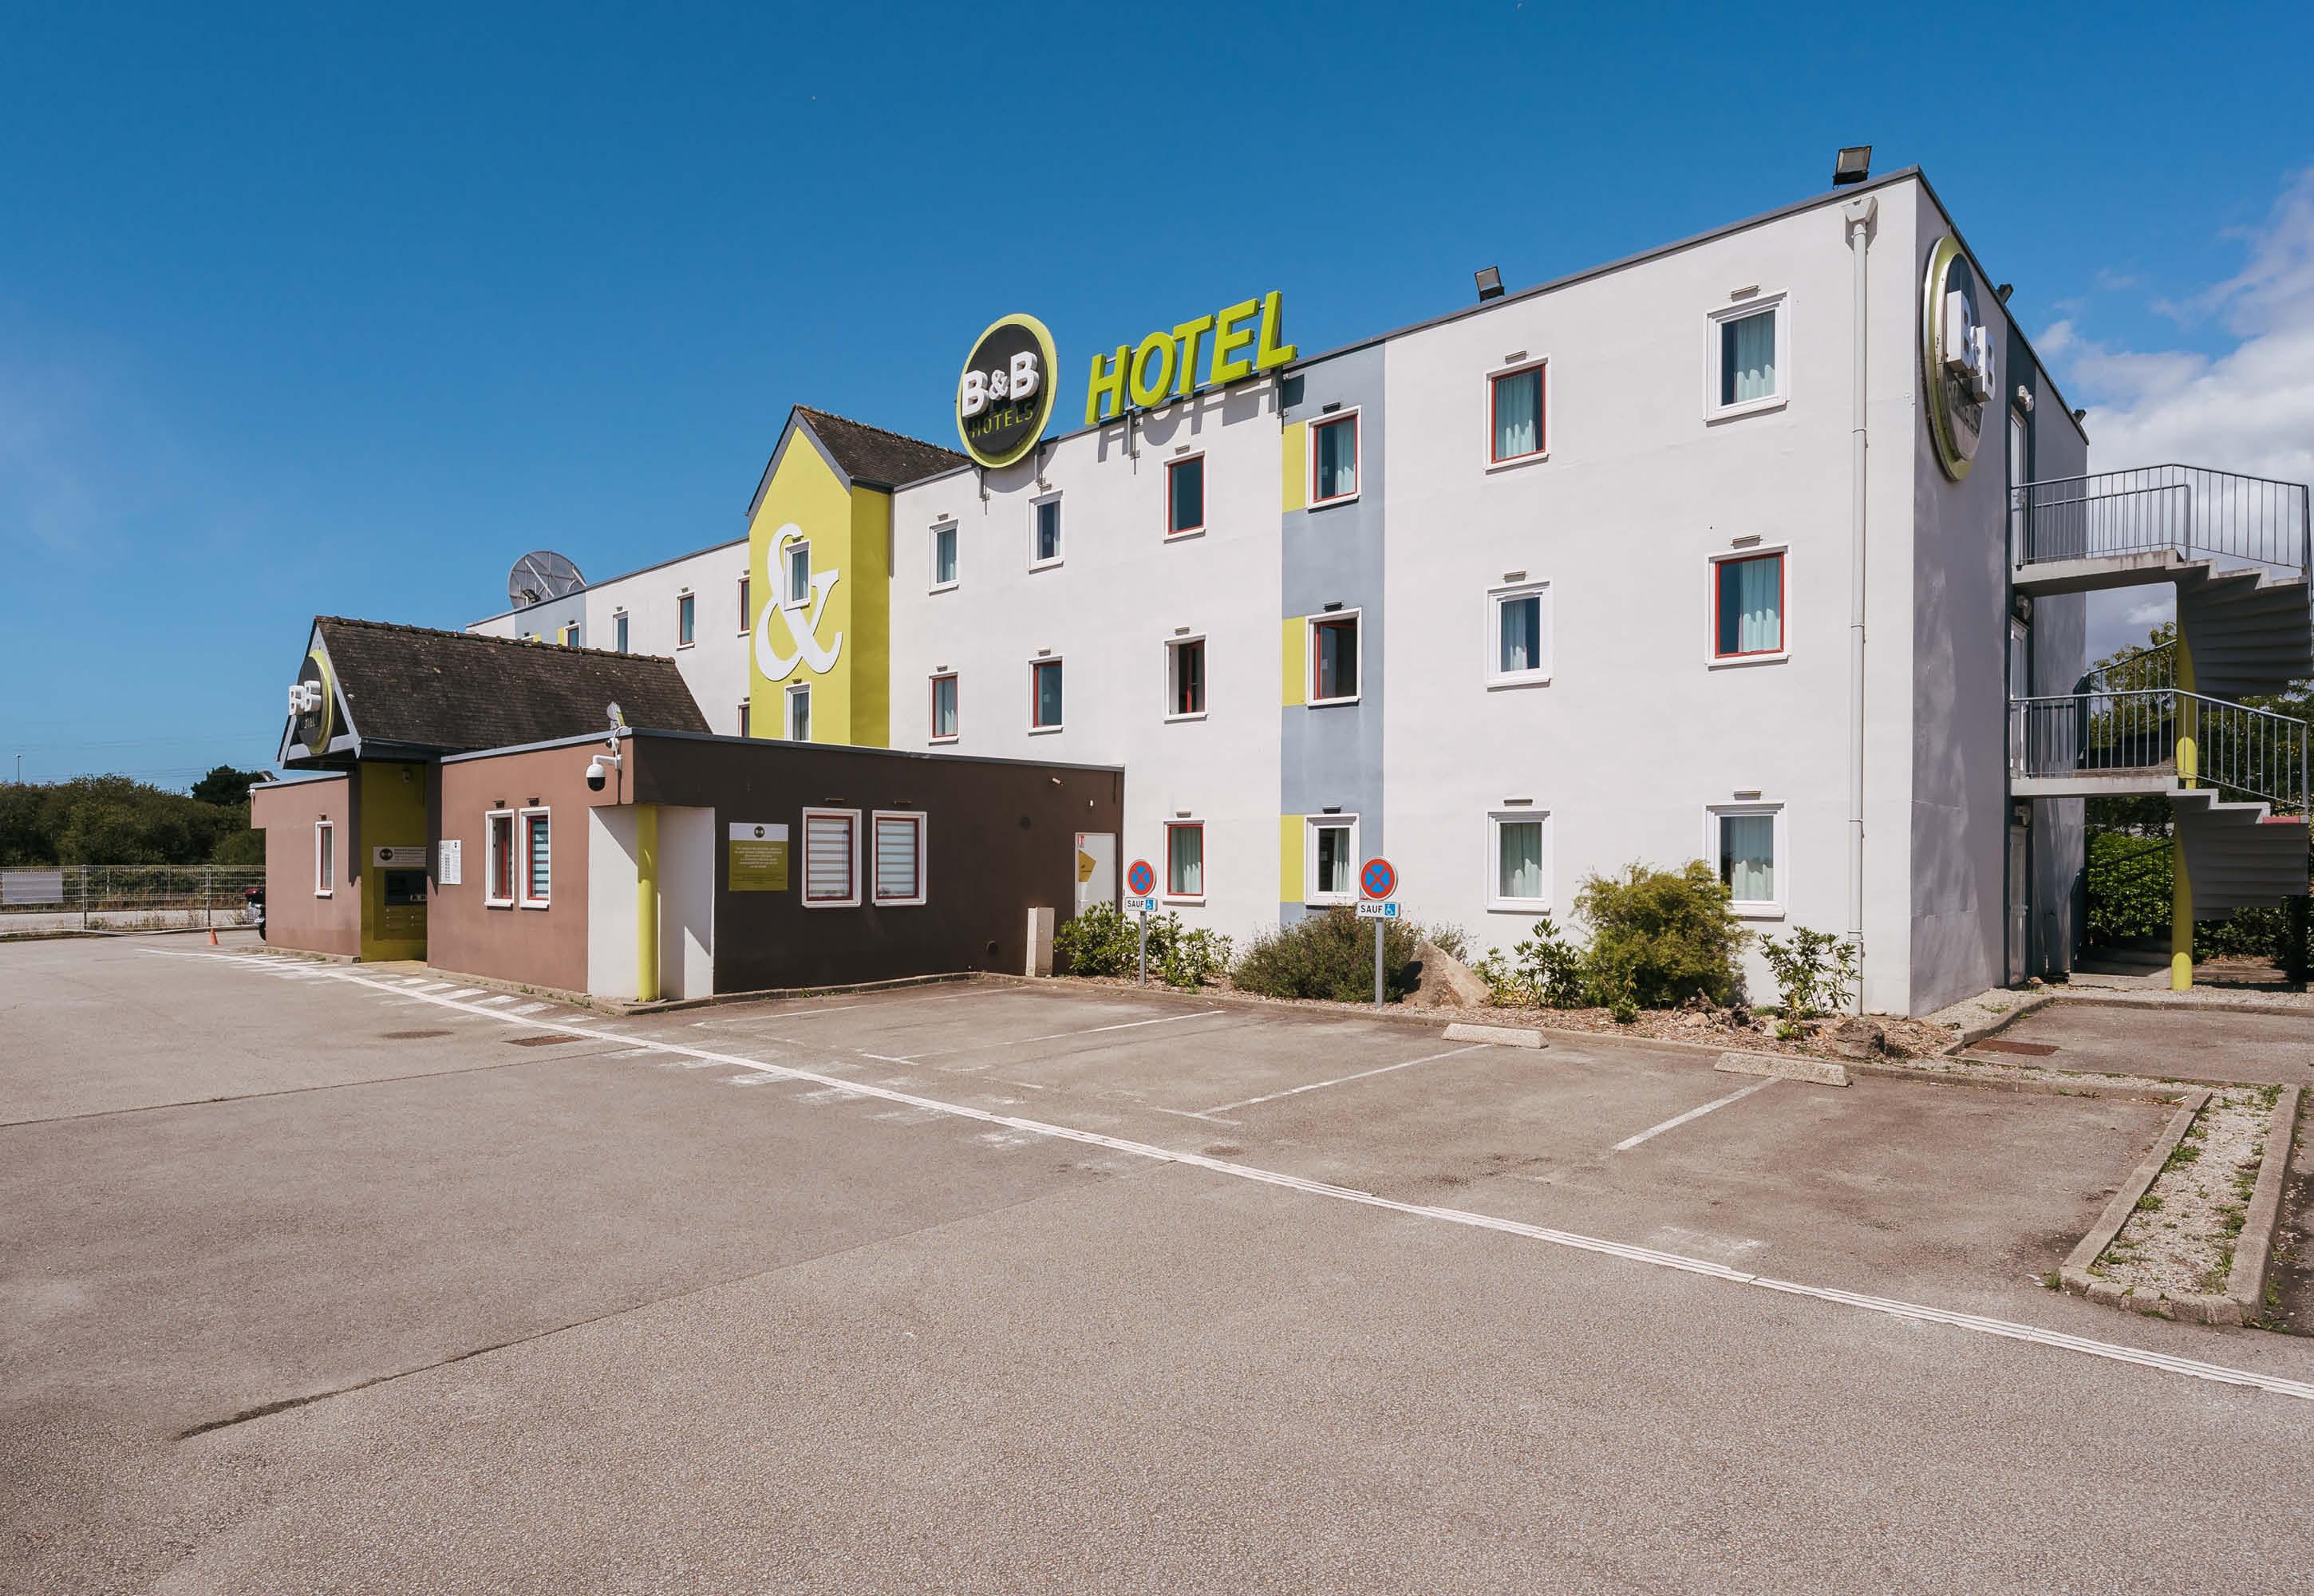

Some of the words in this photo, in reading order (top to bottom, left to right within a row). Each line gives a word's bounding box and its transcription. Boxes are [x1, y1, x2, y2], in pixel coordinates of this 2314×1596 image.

[1085, 290, 1297, 425] HOTEL
[962, 351, 1040, 418] B&B
[970, 402, 1033, 438] HOTELS
[756, 523, 843, 681] &
[289, 680, 322, 716] BB
[1360, 904, 1383, 914] SAUF
